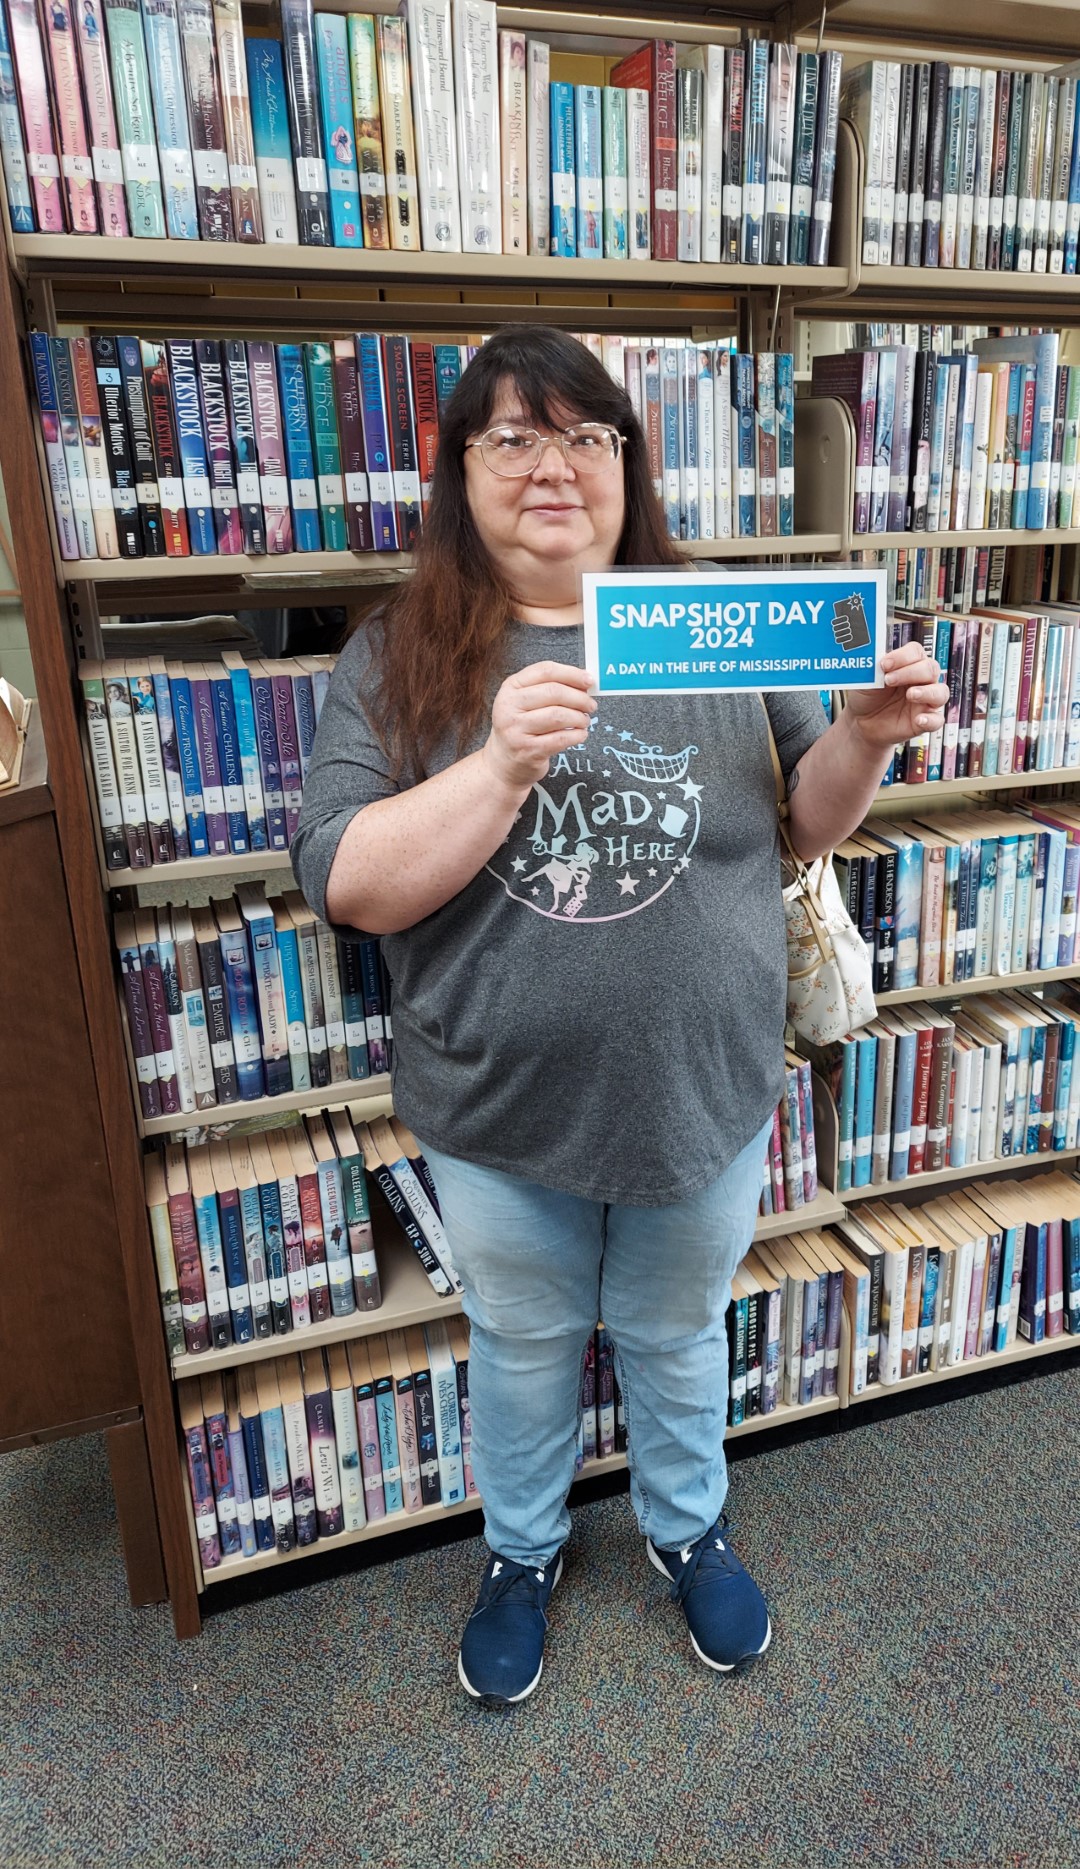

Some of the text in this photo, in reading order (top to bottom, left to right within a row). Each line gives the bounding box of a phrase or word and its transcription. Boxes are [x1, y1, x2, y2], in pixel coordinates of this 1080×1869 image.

[435, 14, 450, 91] Homeward Bound
[90, 51, 107, 117] ALEXANDER
[482, 74, 491, 92] West
[664, 58, 674, 96] CAPE
[751, 48, 766, 124] BLACKSTOCK
[393, 101, 401, 146] DARKNESS
[35, 352, 52, 406] BLACKSTOCK
[57, 357, 73, 410] BLACKSTOCK
[79, 357, 93, 411] BLACKSTOCK
[170, 345, 202, 438] BLACKSTOCK
[322, 366, 333, 407] RIVER'S
[348, 367, 358, 417] BREAKER'S
[360, 338, 382, 412] BLACKSTOCK
[414, 352, 435, 424] BLACKSTOCK
[903, 365, 911, 392] MAID
[229, 360, 254, 439] BLACKSTOCK
[253, 362, 278, 440] BLACKSTOCK
[284, 377, 298, 432] STORM
[292, 365, 307, 429] SOUTHERN
[314, 382, 329, 427] EDGE
[342, 392, 354, 421] REEF
[393, 345, 410, 460] SMOKE SCREEN TERRI
[1024, 387, 1034, 436] GRACE
[104, 387, 125, 456] Ulterior Motives
[126, 376, 145, 429] Presumption
[136, 442, 152, 461] Guilt
[152, 395, 174, 457] BLACKSTOCK
[200, 363, 232, 483] BLACKSTOCK NIGHT
[609, 600, 824, 628] SNAPSHOT DAY
[690, 626, 754, 649] 2024
[1023, 626, 1036, 678] HATCHER
[606, 657, 873, 675] A DAY IN THE LIFE OF MISSISSIPPI LIBRARIES
[257, 686, 271, 709] On
[276, 690, 288, 719] Dear
[299, 687, 312, 719] Going
[94, 731, 105, 751] LADY
[142, 727, 155, 754] VISION
[182, 737, 195, 779] PROMISE
[204, 742, 216, 777] PRAYER
[261, 730, 274, 755] Own
[281, 733, 292, 756] Me
[97, 753, 109, 771] LIKE
[117, 728, 131, 754] SUITOR
[125, 773, 138, 796] JENNY
[148, 769, 161, 788] LUCY
[100, 773, 114, 798] SARAH
[884, 870, 895, 914] HENDERSON
[306, 955, 315, 977] AMISH
[325, 951, 333, 973] AMISH
[169, 972, 179, 1006] CARLSON
[261, 962, 277, 1029] PIRATE LADY
[327, 974, 335, 999] NANNY
[136, 1015, 144, 1036] Love
[213, 1003, 226, 1037] EMPIRE
[920, 1064, 929, 1089] Home
[917, 1099, 927, 1122] Holly
[936, 1084, 947, 1119] Company
[261, 1188, 272, 1223] COBLE
[280, 1185, 291, 1223] COBLE
[288, 1183, 298, 1220] COLLEEN
[324, 1170, 339, 1223] COLLEEN COBLE
[350, 1165, 364, 1215] COLLEEN COBLE
[378, 1173, 406, 1213] COLLINS
[401, 1178, 428, 1222] COLLINS
[243, 1194, 254, 1229] COBLE
[748, 1301, 757, 1340] SHOOFLY
[871, 1286, 879, 1326] KINGSBURY
[736, 1331, 744, 1360] DOWNS
[439, 1380, 450, 1448] IVES CHRISTMAS
[448, 1391, 457, 1428] CURRIER
[296, 1443, 304, 1472] VALLEY
[315, 1404, 331, 1474] CRAMER Levi's
